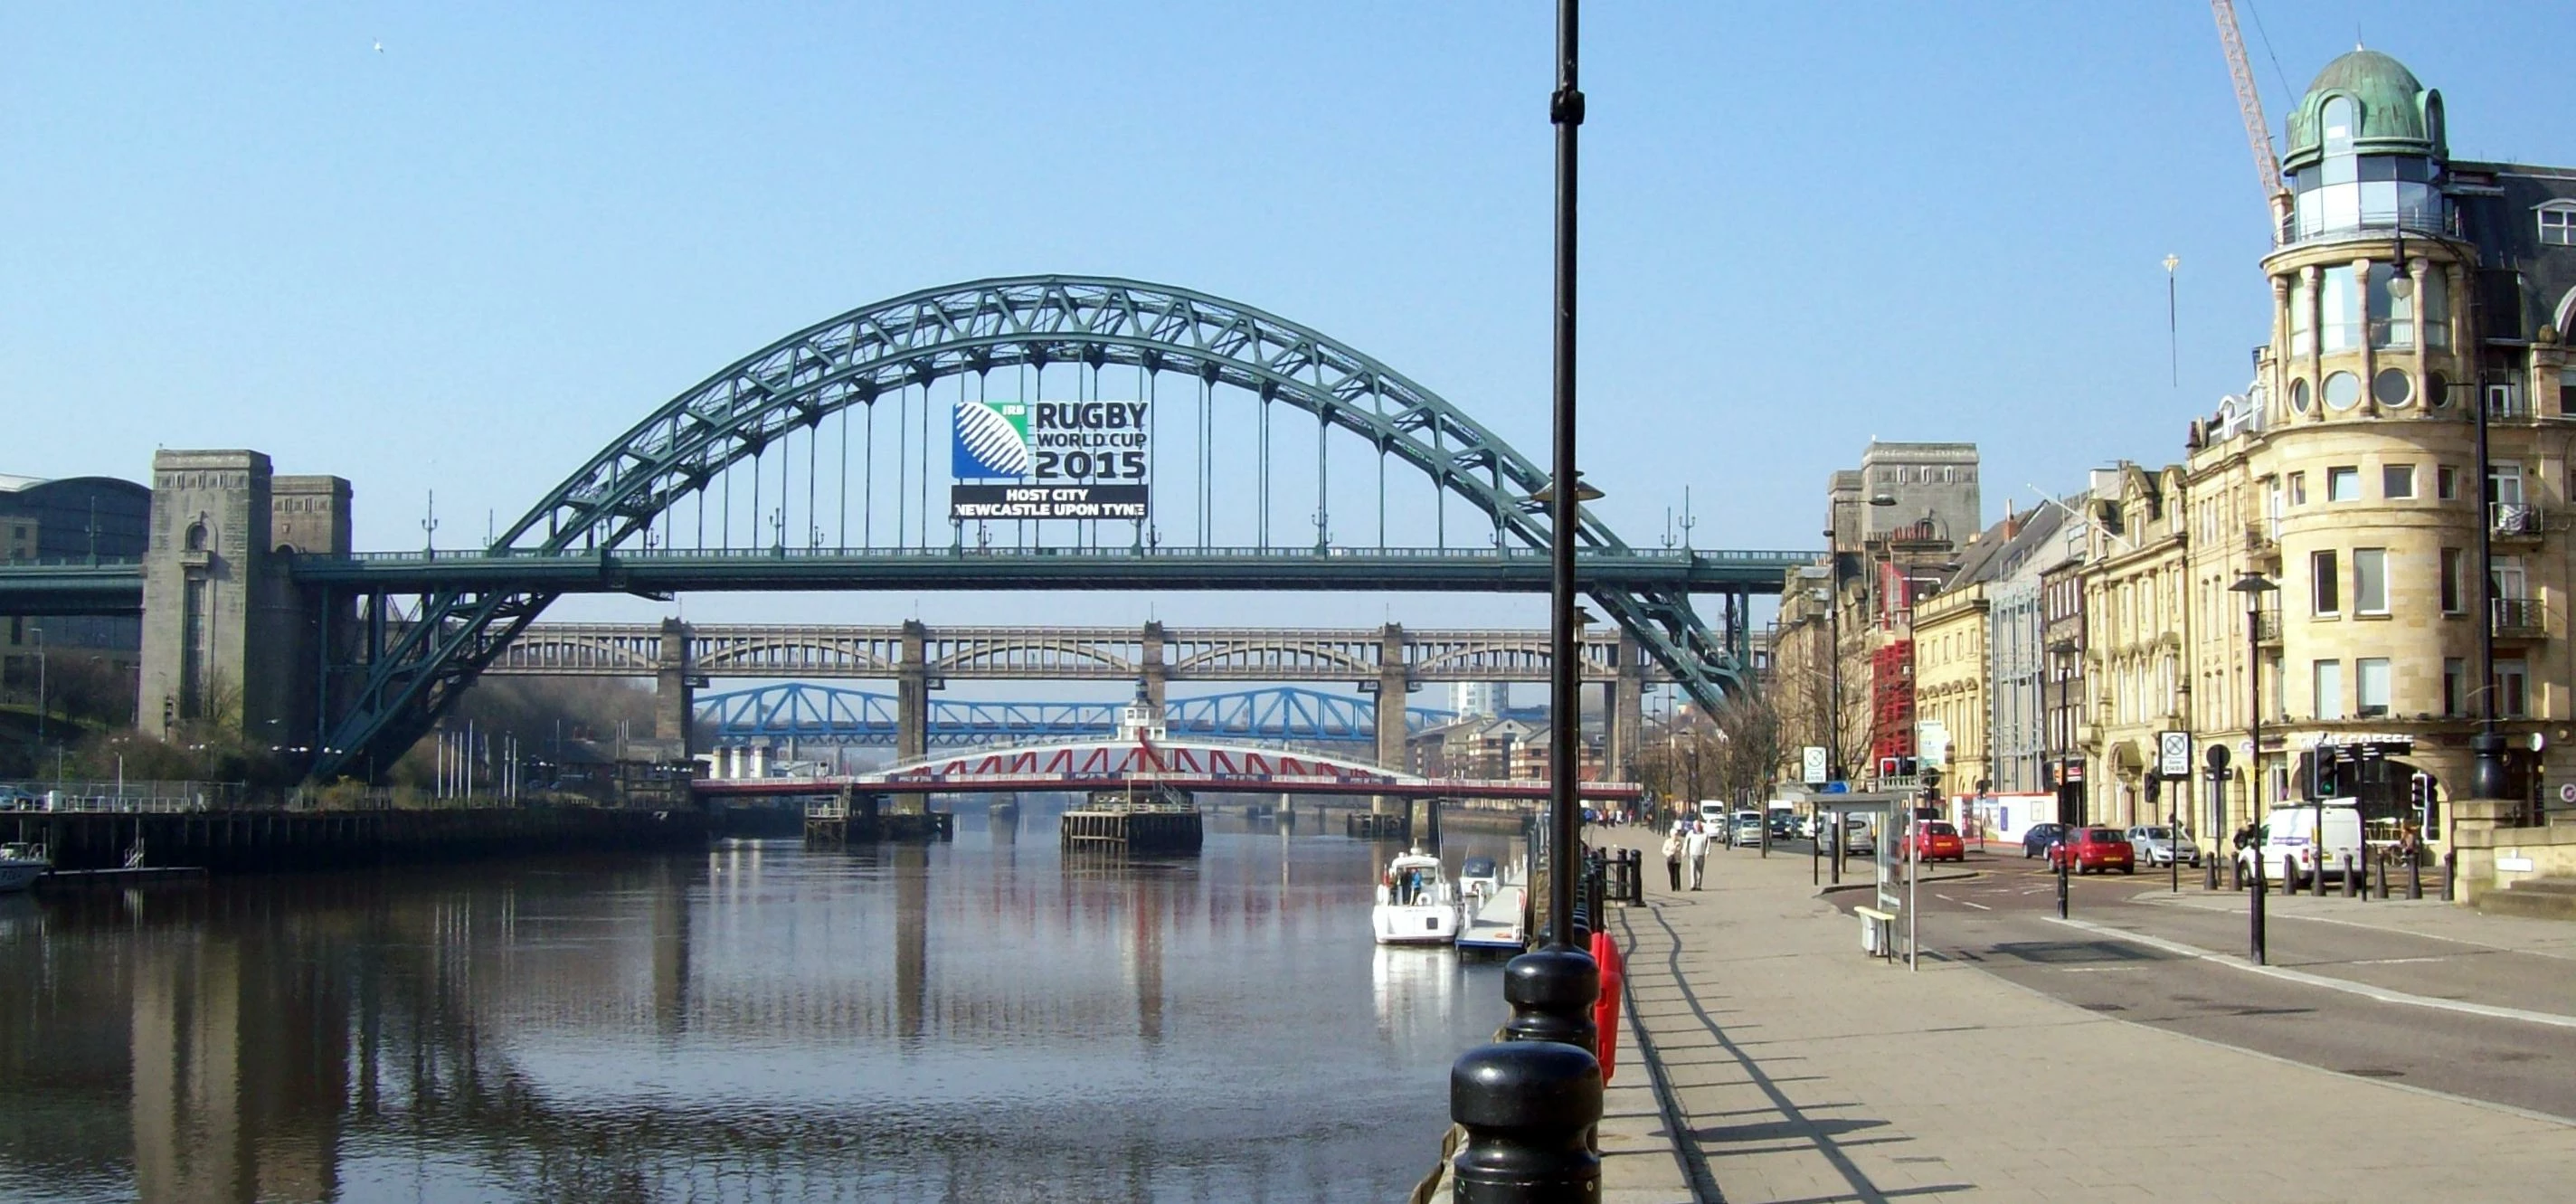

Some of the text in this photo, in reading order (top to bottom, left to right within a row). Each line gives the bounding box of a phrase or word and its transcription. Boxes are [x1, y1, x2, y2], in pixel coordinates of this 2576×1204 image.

[1037, 403, 1148, 429] RUGBY
[1037, 433, 1147, 447] WORLD CUP
[1036, 451, 1146, 479] 2015
[1006, 489, 1088, 501] HOST CITY
[955, 504, 1144, 516] NEWCASTLE UPON TYNE
